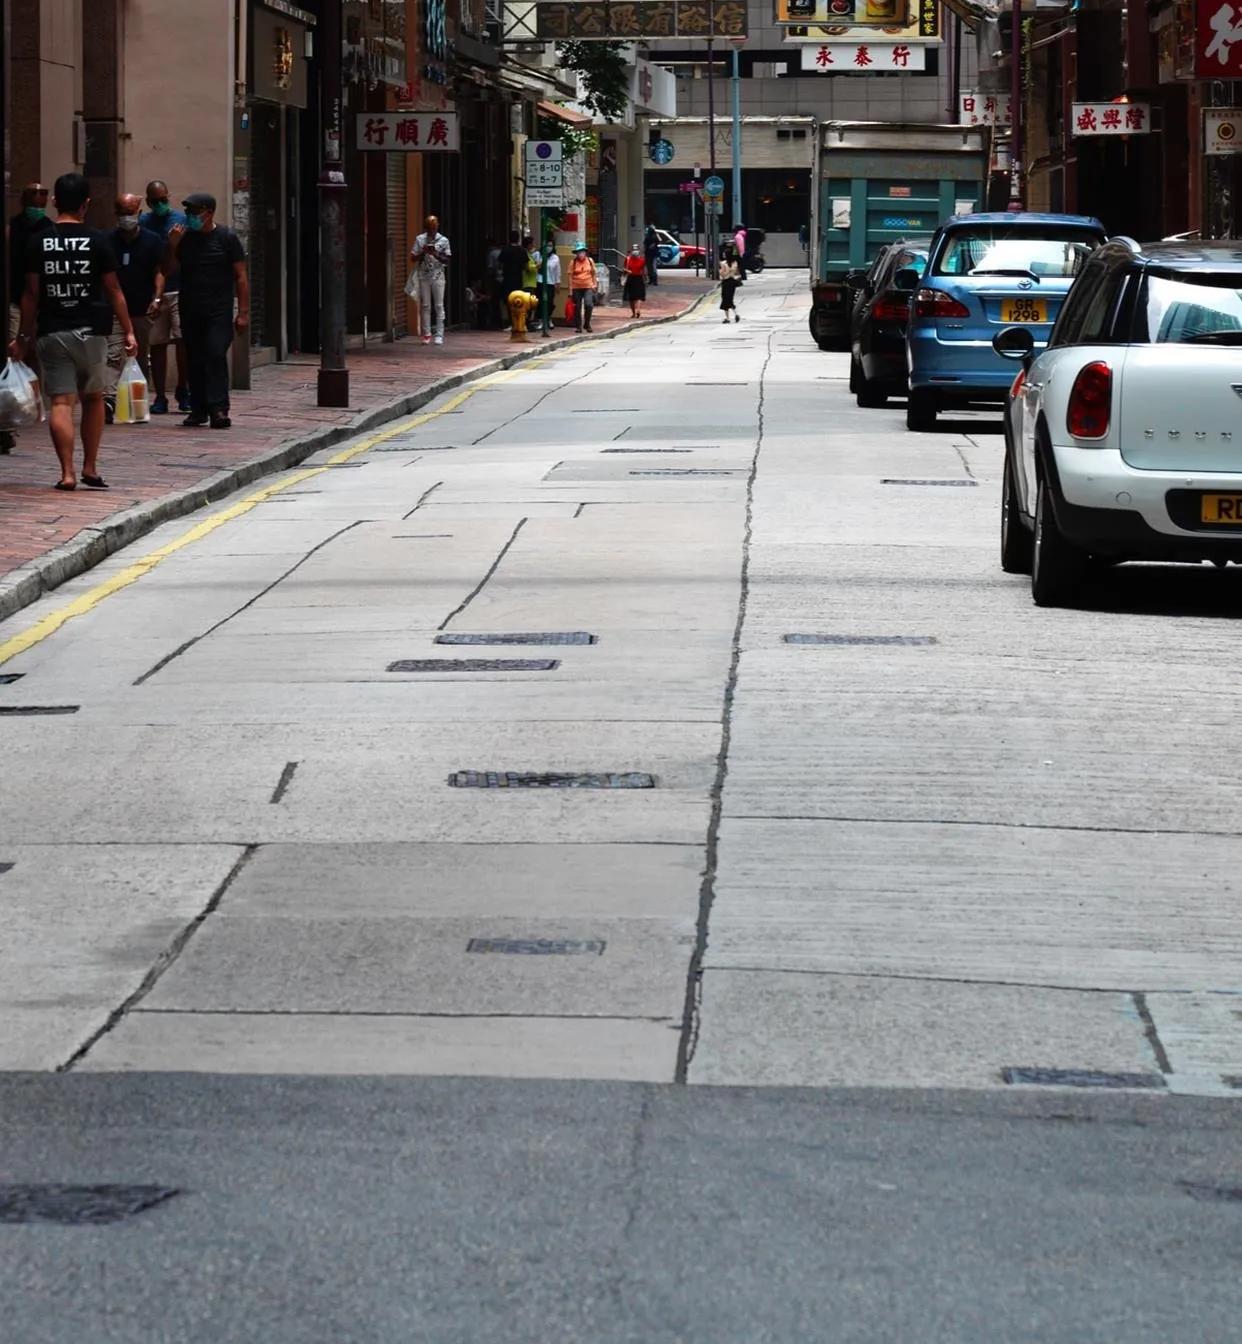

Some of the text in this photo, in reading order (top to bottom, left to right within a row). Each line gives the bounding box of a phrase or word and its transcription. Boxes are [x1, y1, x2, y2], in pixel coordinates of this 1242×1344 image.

[816, 46, 912, 67] 永泰行
[1077, 108, 1145, 131] 盛興隆
[43, 237, 90, 251] BLITZ
[1015, 299, 1034, 310] GR
[1008, 310, 1040, 322] 1298
